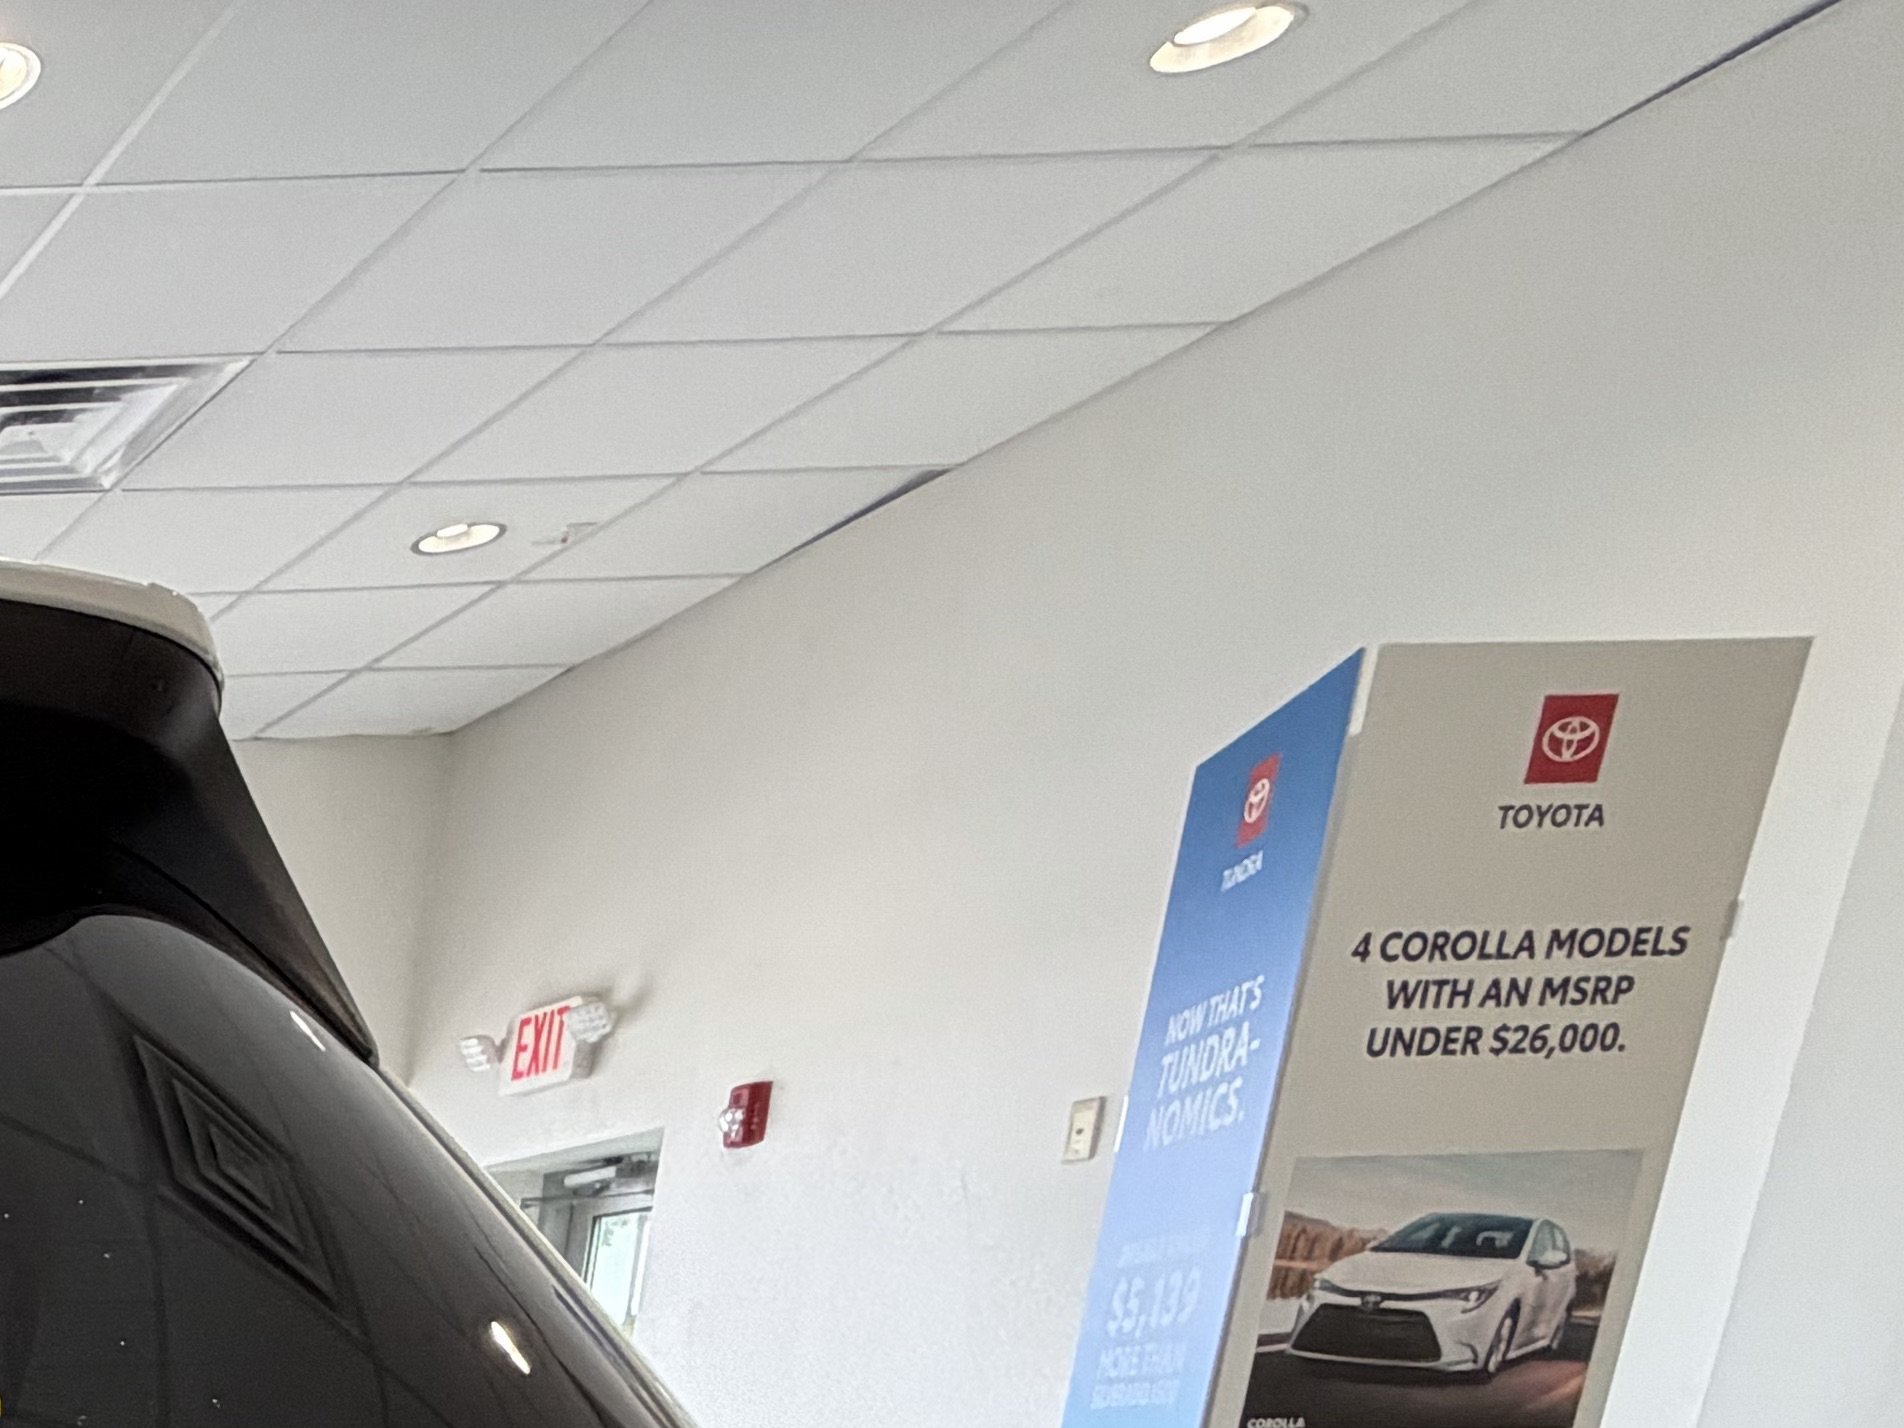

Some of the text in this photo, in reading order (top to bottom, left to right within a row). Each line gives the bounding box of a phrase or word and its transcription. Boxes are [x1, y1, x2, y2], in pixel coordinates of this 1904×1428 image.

[1496, 801, 1605, 830] TOYOTA
[1350, 925, 1691, 964] 4 COROLLA MODELS
[1164, 974, 1265, 1047] NOW THAT'S
[1385, 974, 1636, 1010] WITH AN MSRP
[511, 1005, 572, 1081] EXIT
[1157, 1020, 1260, 1099] TUNDRA-
[1366, 1021, 1627, 1061] UNDER $26,000.
[1145, 1075, 1245, 1149] NOMICS.
